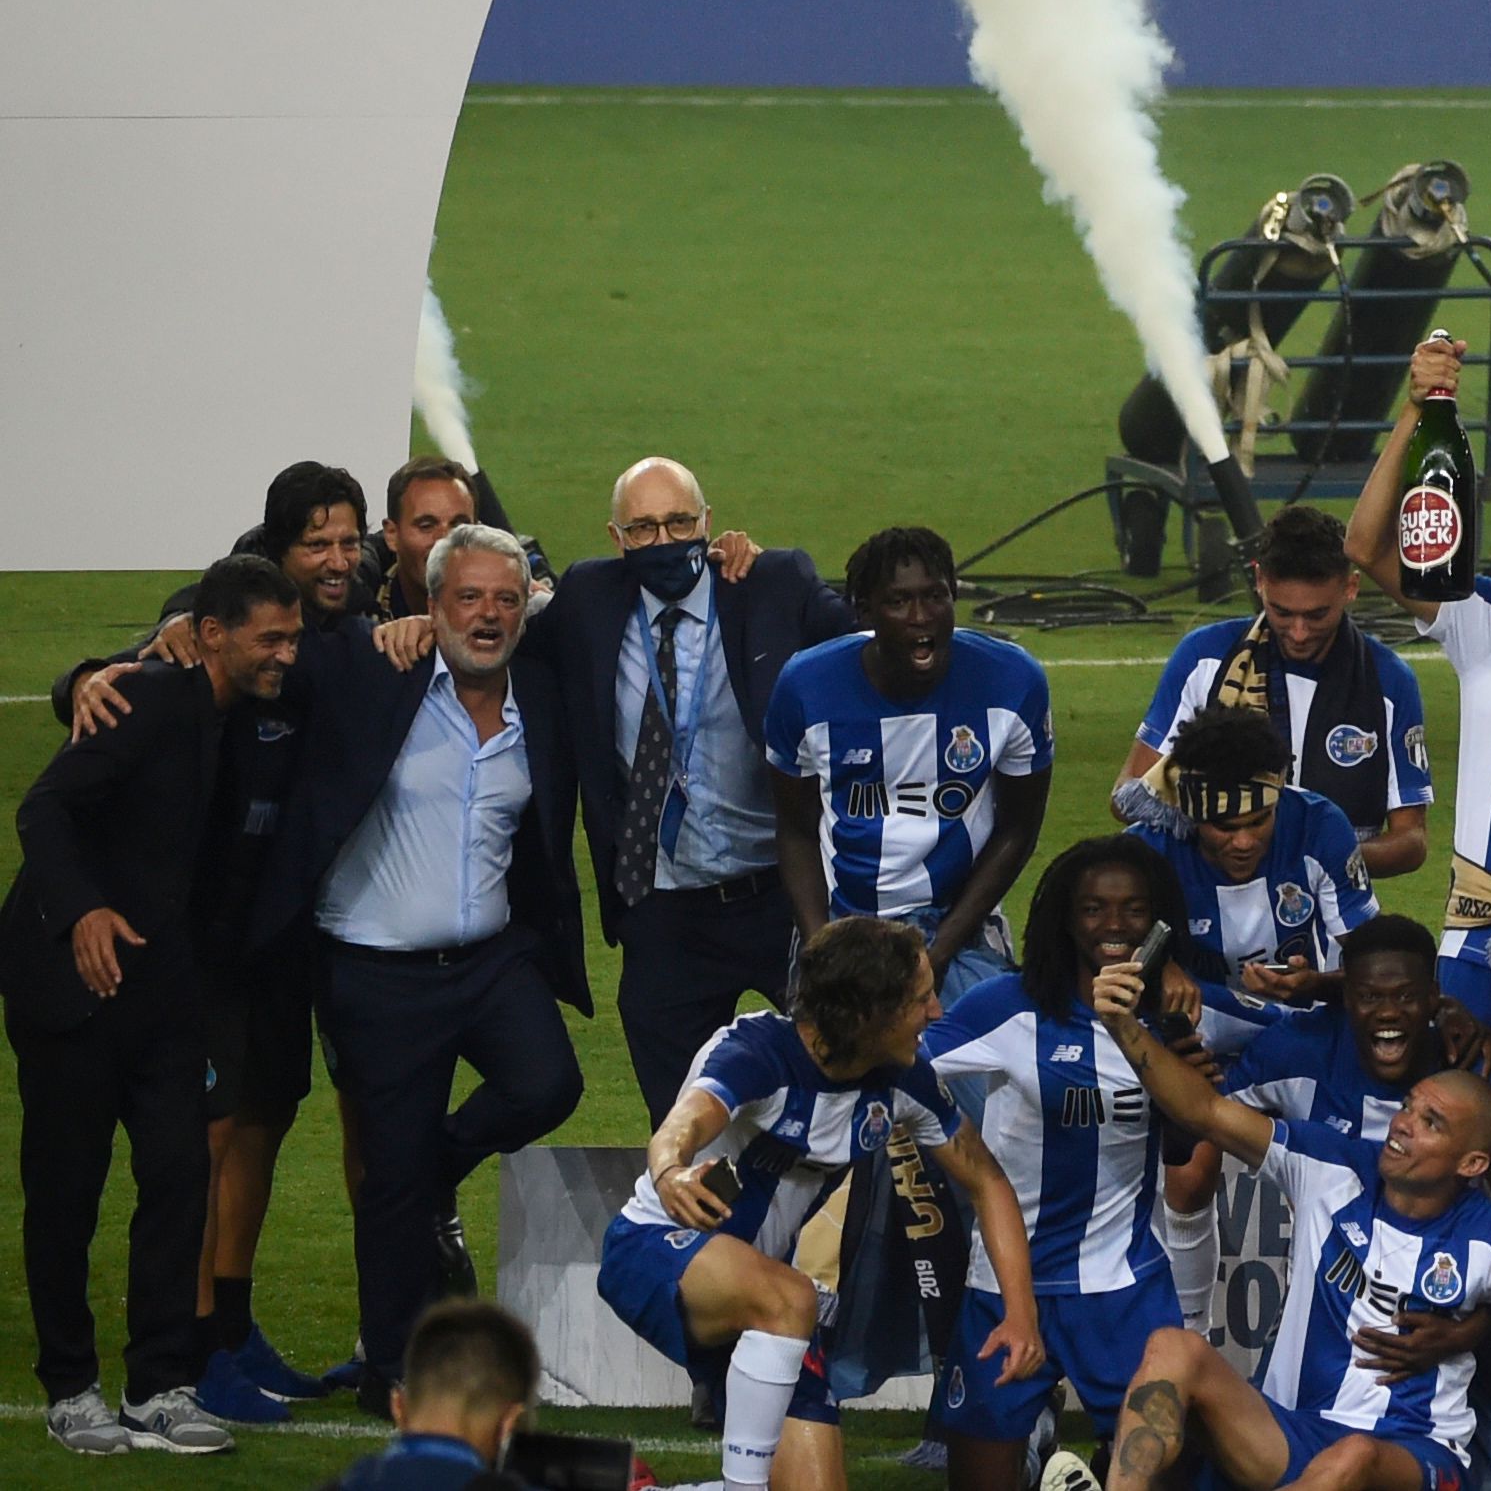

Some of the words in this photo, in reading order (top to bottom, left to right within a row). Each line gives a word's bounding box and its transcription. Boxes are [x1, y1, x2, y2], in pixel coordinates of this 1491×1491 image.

[1401, 508, 1453, 527] SUPER
[1402, 527, 1449, 547] BOCK
[847, 779, 975, 820] MEO
[1061, 1085, 1144, 1128] ME
[914, 1259, 941, 1300] 2019
